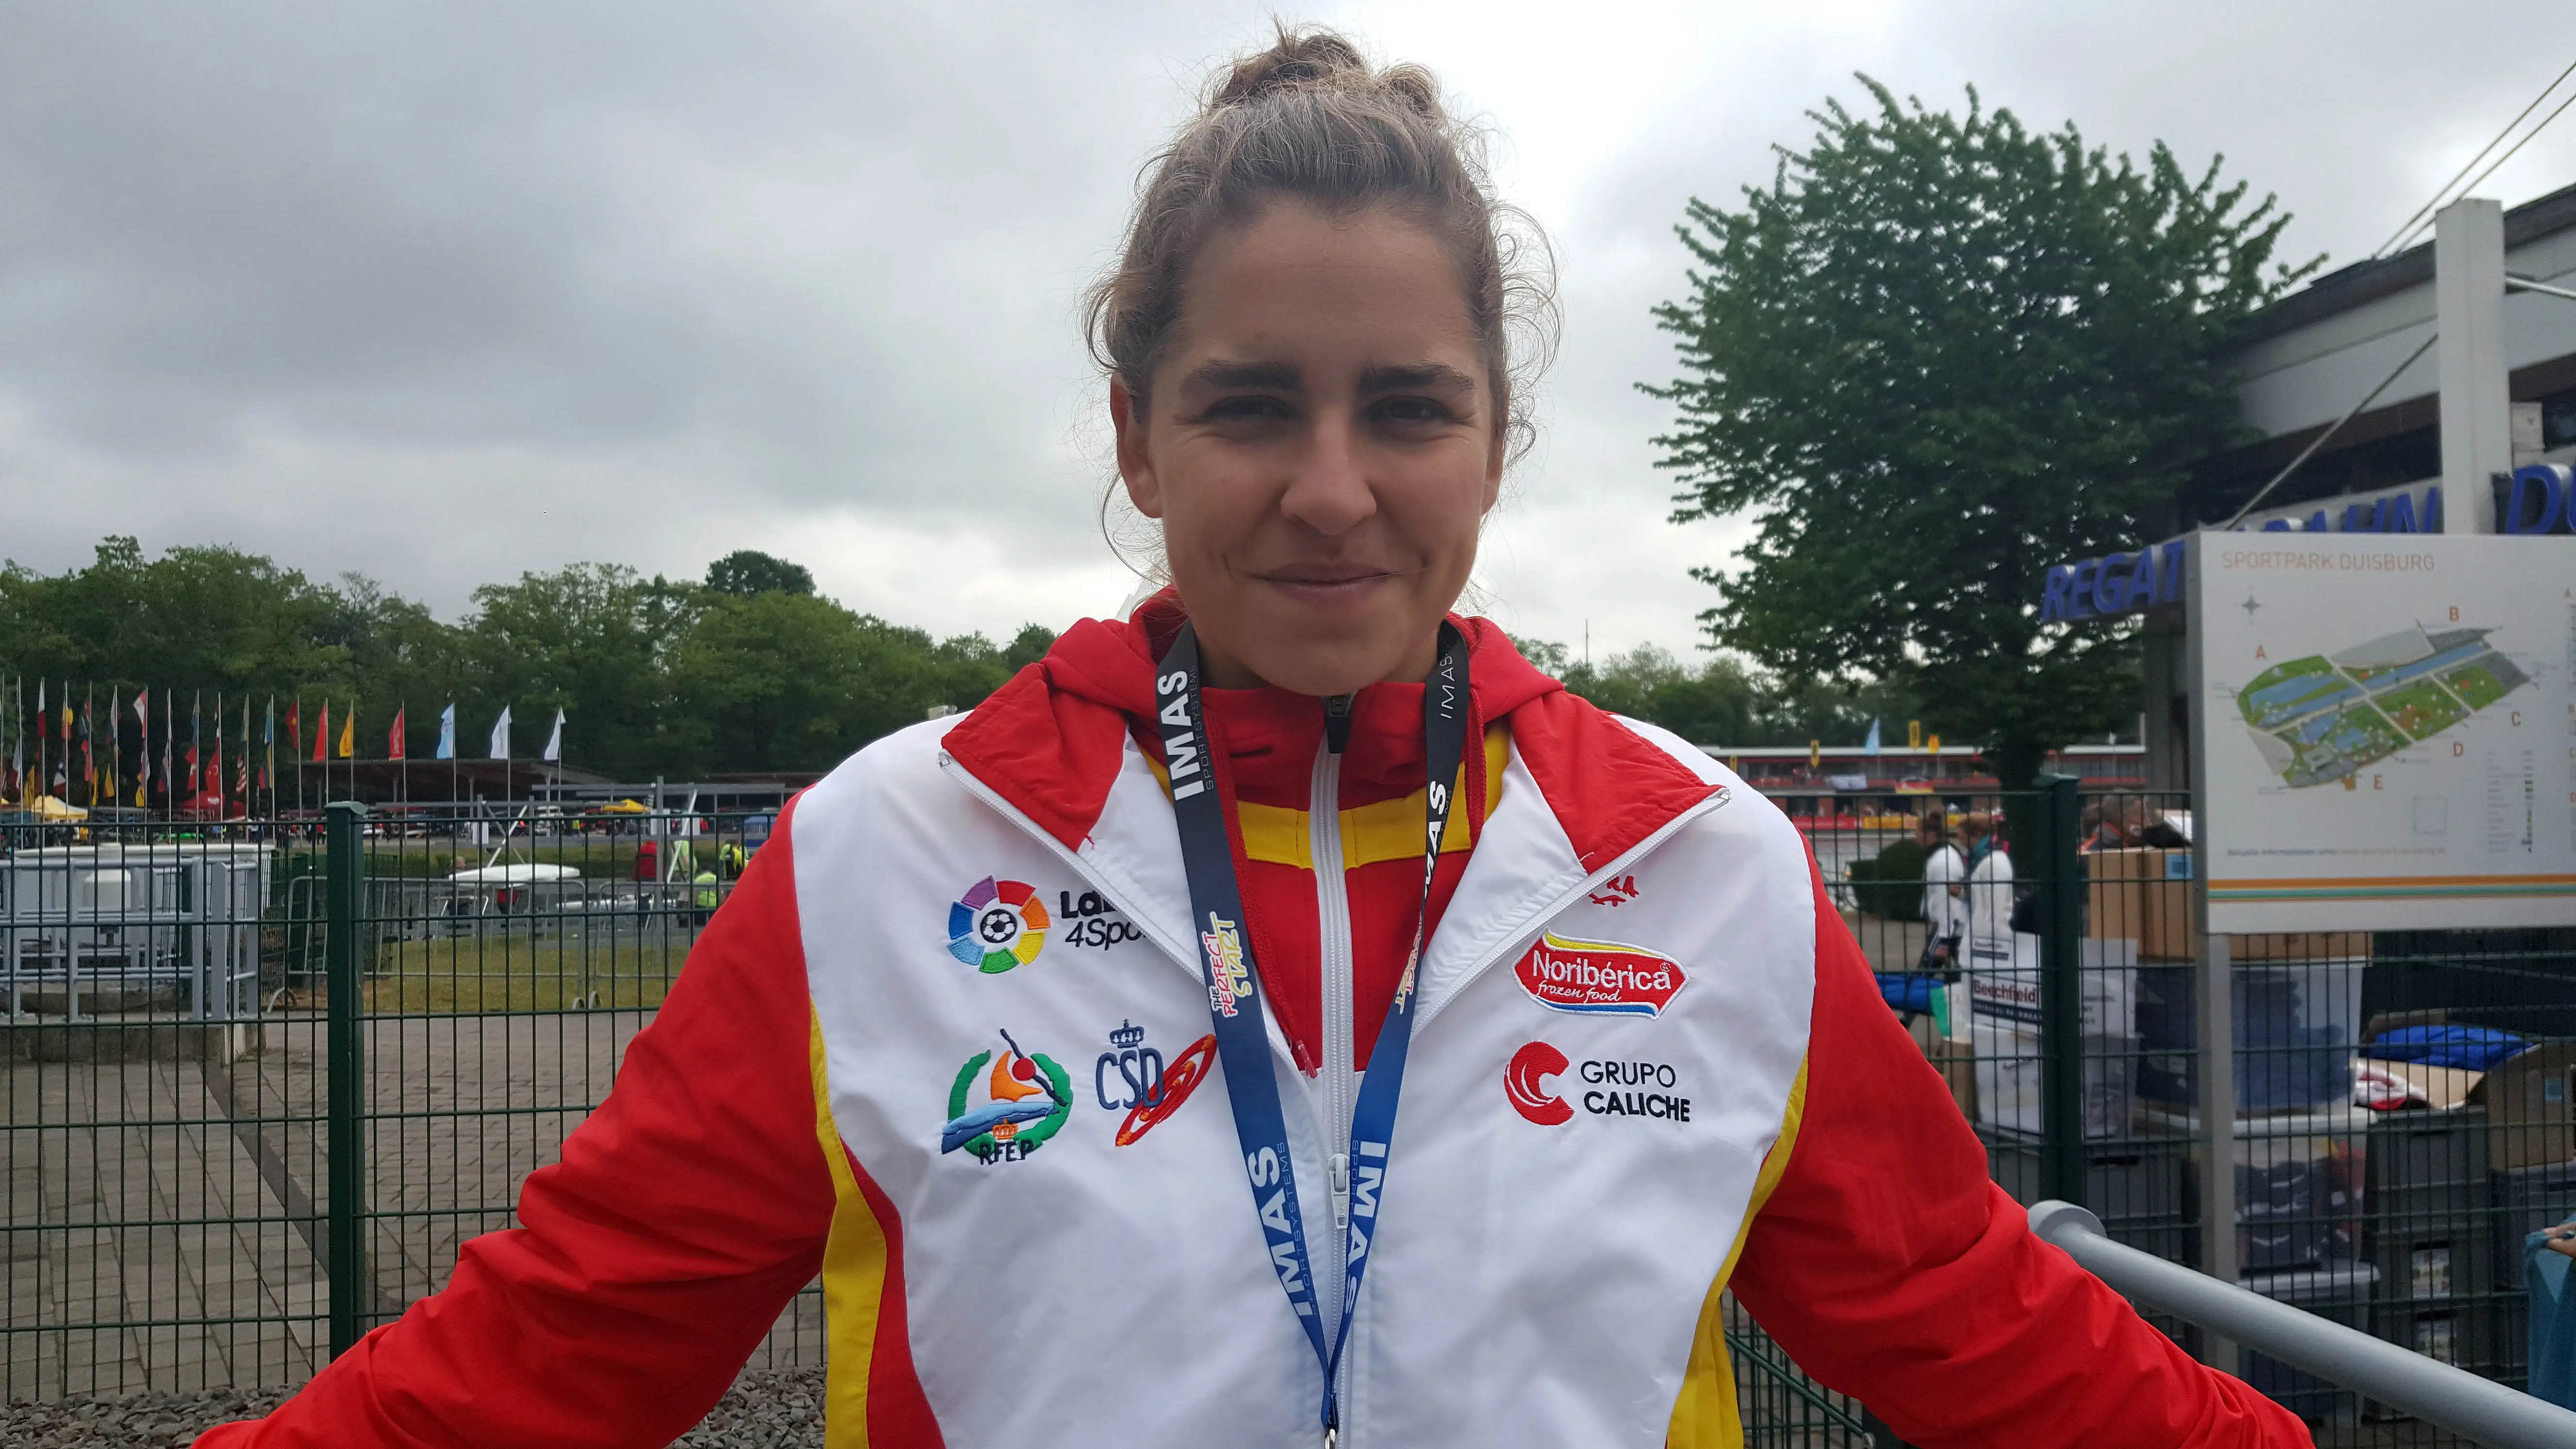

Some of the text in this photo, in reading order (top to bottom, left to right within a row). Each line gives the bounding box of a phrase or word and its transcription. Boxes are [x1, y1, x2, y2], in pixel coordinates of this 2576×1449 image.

[2222, 551, 2435, 572] SPORTPARK DUISBURG
[2449, 606, 2459, 621] B
[2255, 645, 2266, 659] A
[2512, 711, 2521, 726] C
[1158, 671, 1205, 801] IMAS
[2453, 741, 2463, 757] D
[2374, 775, 2383, 790] E
[1424, 781, 1446, 900] MAS
[1065, 918, 1147, 951] 4Spo
[1212, 912, 1251, 996] START
[1204, 933, 1237, 1016] PERFECT
[1212, 987, 1223, 1009] THE
[1537, 980, 1622, 1004] frozen food
[1095, 1047, 1164, 1110] CSD
[1580, 1061, 1676, 1088] GRUPO
[1583, 1091, 1691, 1123] CALICHE
[980, 1142, 1033, 1165] RFEP
[1248, 1146, 1313, 1316] IMAS
[1345, 1141, 1387, 1315] IMAS
